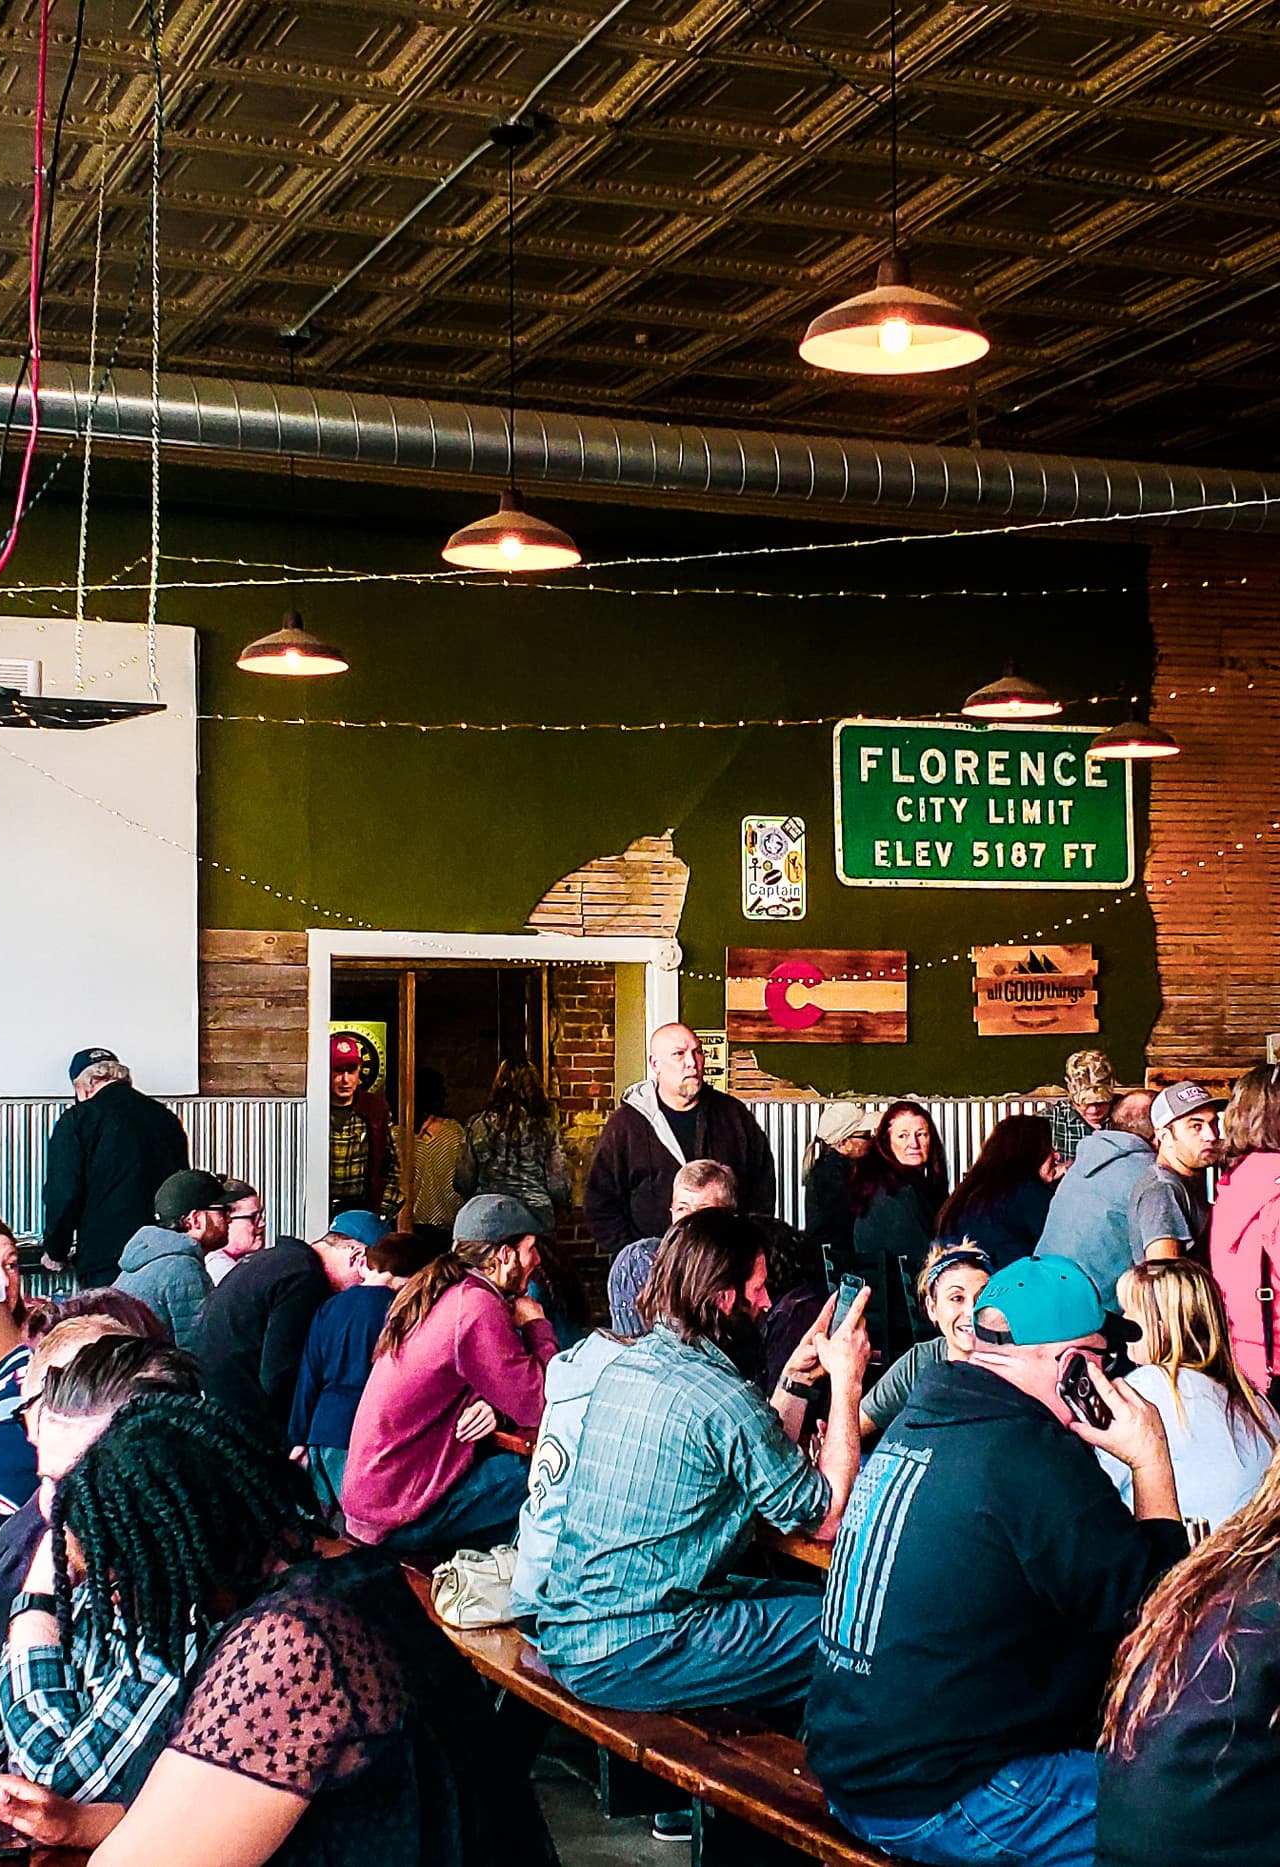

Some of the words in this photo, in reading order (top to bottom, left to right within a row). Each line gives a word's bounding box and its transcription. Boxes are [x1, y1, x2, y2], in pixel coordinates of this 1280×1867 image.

[860, 746, 1109, 788] FLORENCE
[896, 796, 966, 824] CITY
[988, 798, 1075, 826] LIMIT
[874, 840, 953, 868] ELEV
[972, 842, 1046, 870] 5187
[1063, 842, 1097, 870] FT
[748, 883, 800, 898] Captain
[988, 983, 1002, 1000] all
[1004, 980, 1044, 1002] GOOD
[1045, 982, 1086, 1003] things
